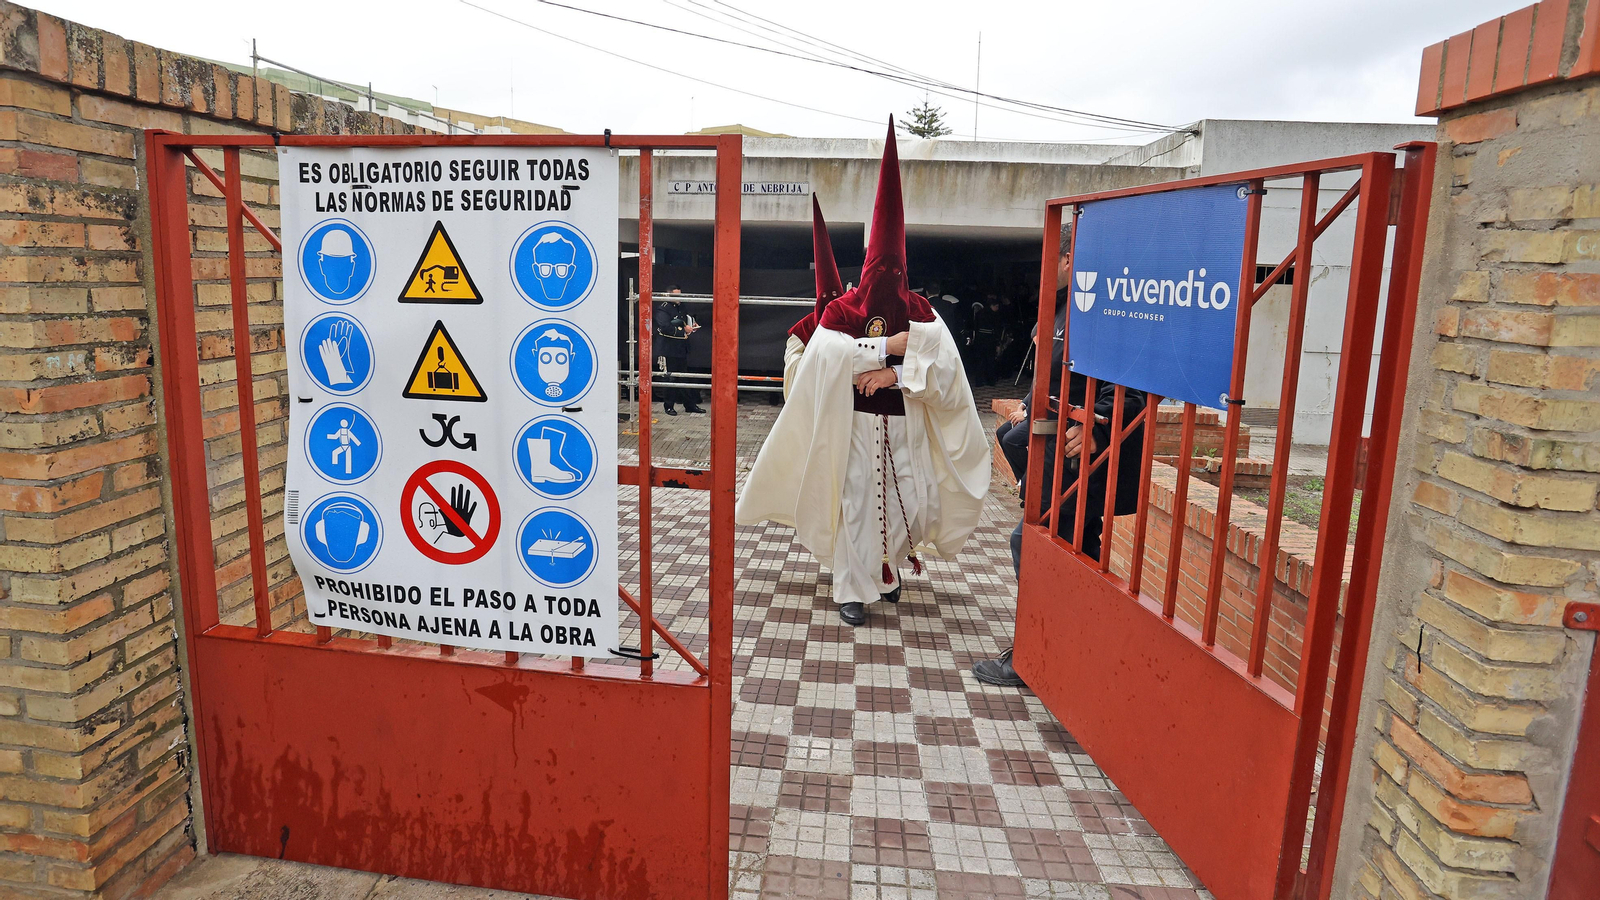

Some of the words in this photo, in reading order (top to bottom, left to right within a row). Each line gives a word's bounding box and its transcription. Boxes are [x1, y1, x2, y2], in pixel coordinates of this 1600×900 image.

[299, 163, 322, 184] ES
[329, 160, 442, 183] OBLIGATORIO
[449, 159, 520, 181] SEGUIR
[527, 158, 590, 181] TODAS
[674, 183, 679, 191] C
[686, 183, 691, 191] P
[744, 184, 754, 192] DE
[761, 184, 802, 192] NEBRIJA
[315, 192, 347, 213] LAS
[352, 190, 426, 212] NORMAS
[432, 190, 454, 211] DE
[461, 189, 572, 211] SEGURIDAD
[1106, 267, 1231, 310] vivendio
[1104, 308, 1126, 317] GRUPO
[1128, 312, 1165, 322] ACONSER
[314, 575, 422, 605] PROHIBIDO
[430, 587, 455, 607] EL
[463, 588, 517, 611] PASO
[524, 594, 538, 613] A
[544, 595, 602, 618] TODA
[327, 599, 412, 631] PERSONA
[417, 615, 482, 638] AJENA
[488, 620, 502, 639] A
[509, 622, 534, 642] LA
[540, 624, 597, 647] OBRA
